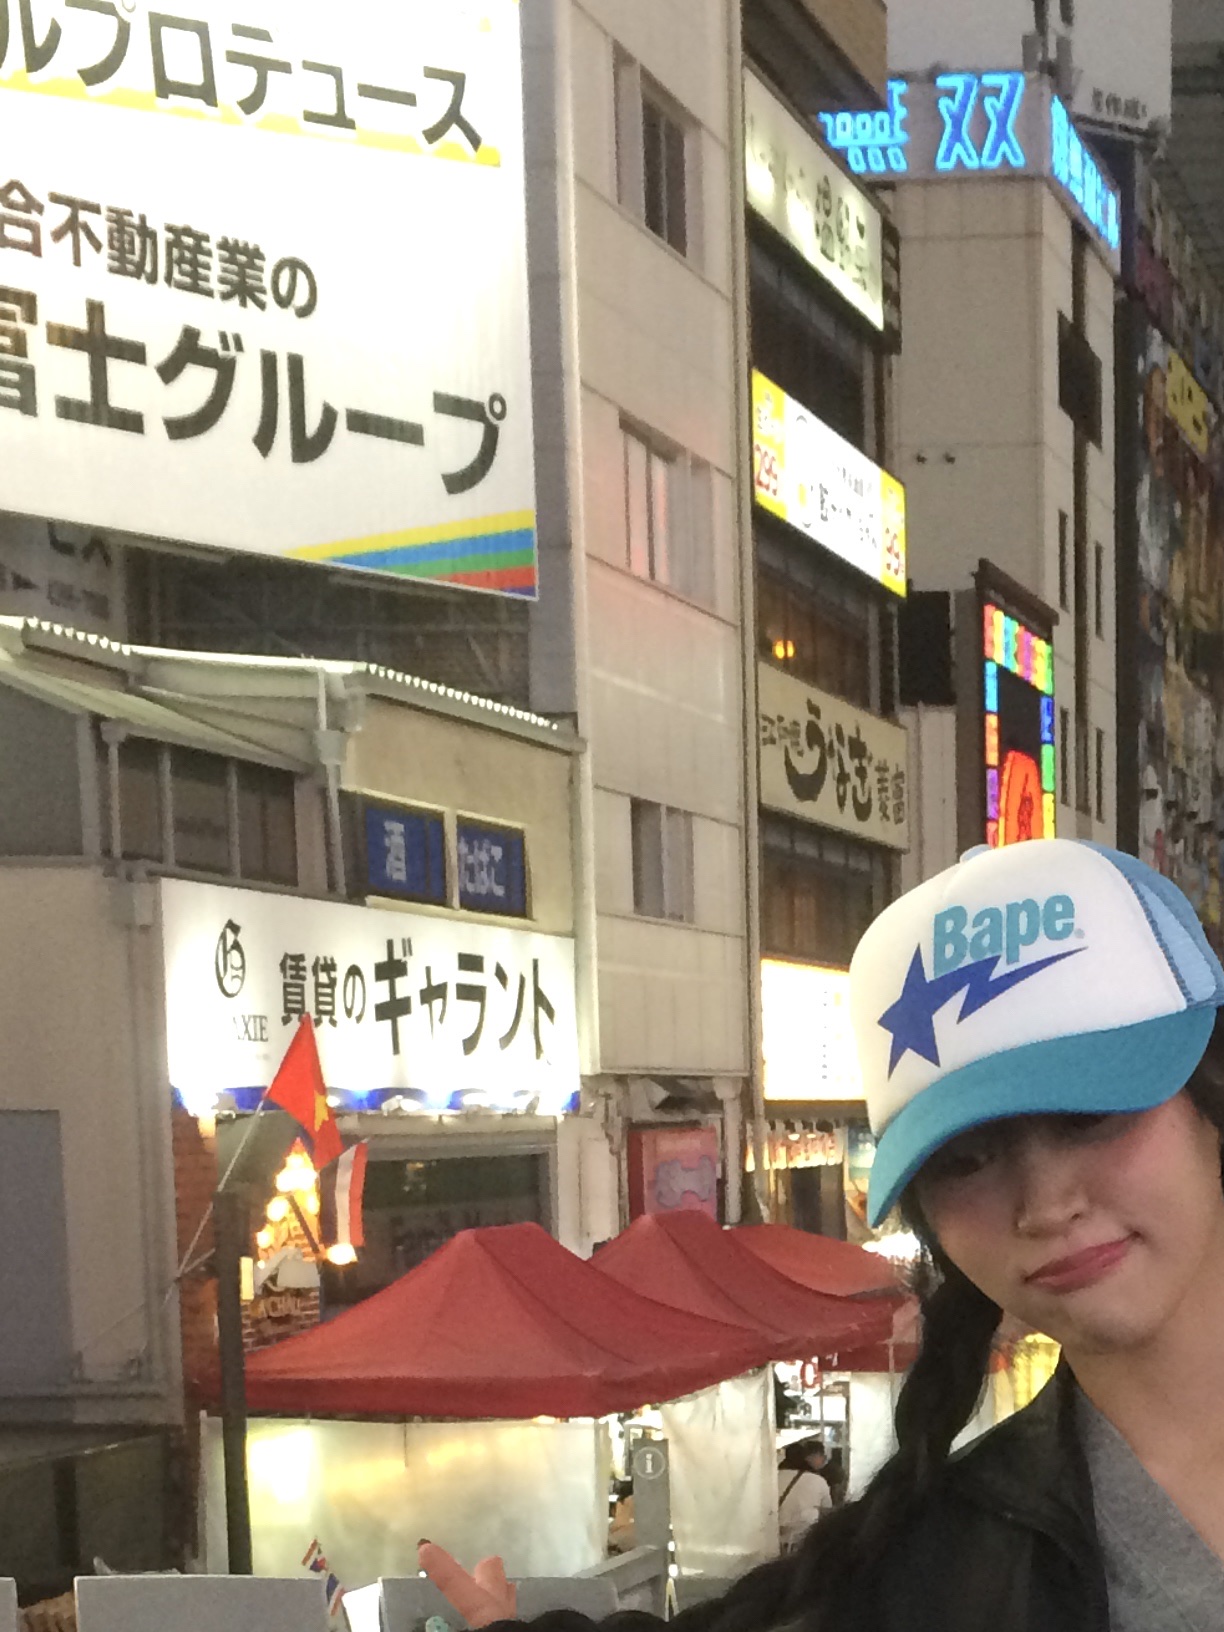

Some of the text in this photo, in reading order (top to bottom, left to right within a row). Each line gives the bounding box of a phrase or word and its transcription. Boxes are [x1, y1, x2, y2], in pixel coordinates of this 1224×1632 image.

[0, 178, 318, 319] 合不動産業の
[383, 820, 407, 882] 酒
[458, 836, 505, 898] たばこ
[933, 894, 1075, 979] Bape
[279, 937, 556, 1060] 賃貸のギャラント
